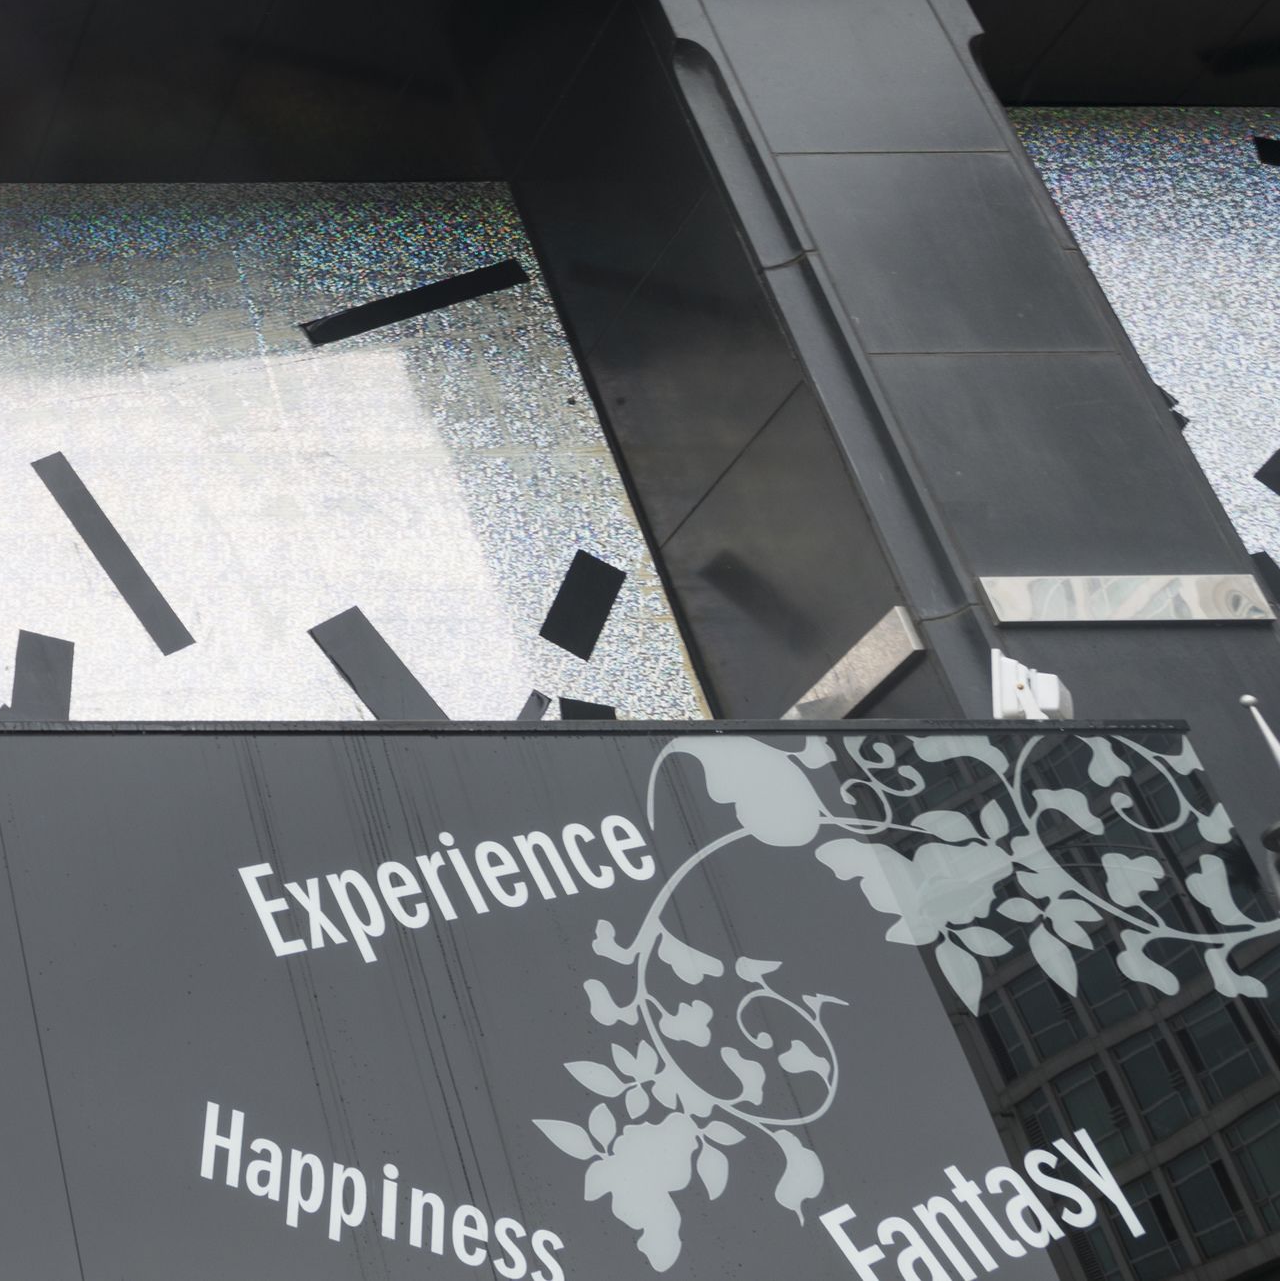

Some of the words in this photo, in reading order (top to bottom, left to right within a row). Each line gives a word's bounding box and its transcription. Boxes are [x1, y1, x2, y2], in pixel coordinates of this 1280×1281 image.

[239, 813, 655, 962] Experience
[200, 1101, 566, 1281] Happiness
[819, 1127, 1146, 1281] Fantasy
